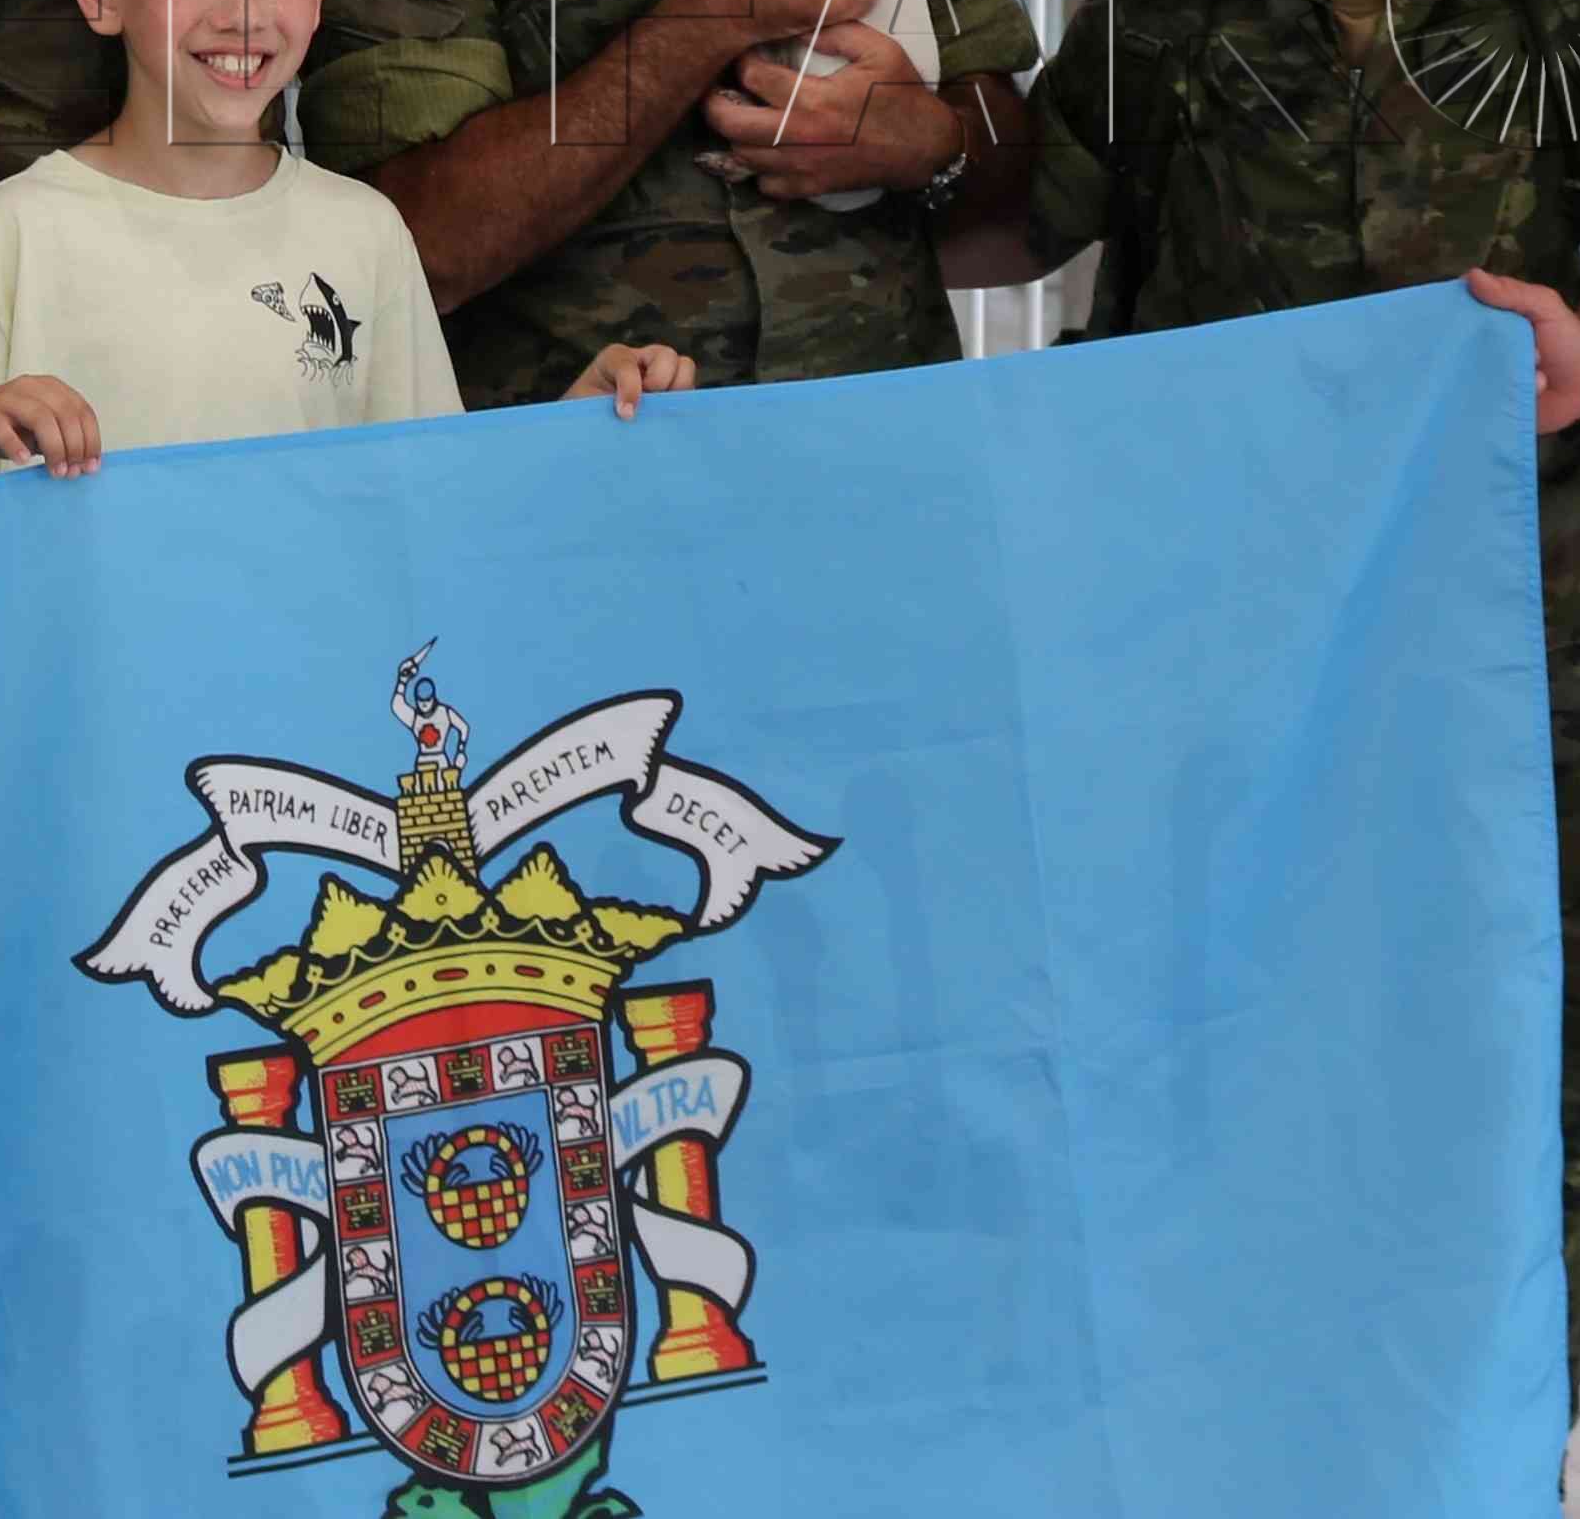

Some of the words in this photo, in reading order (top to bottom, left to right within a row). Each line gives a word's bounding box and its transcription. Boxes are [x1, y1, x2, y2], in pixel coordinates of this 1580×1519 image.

[228, 789, 316, 823] PATRIAM
[330, 804, 388, 858] LIBER
[486, 740, 615, 822] PARENTEM
[665, 792, 749, 855] DECET
[206, 1150, 263, 1203] NON
